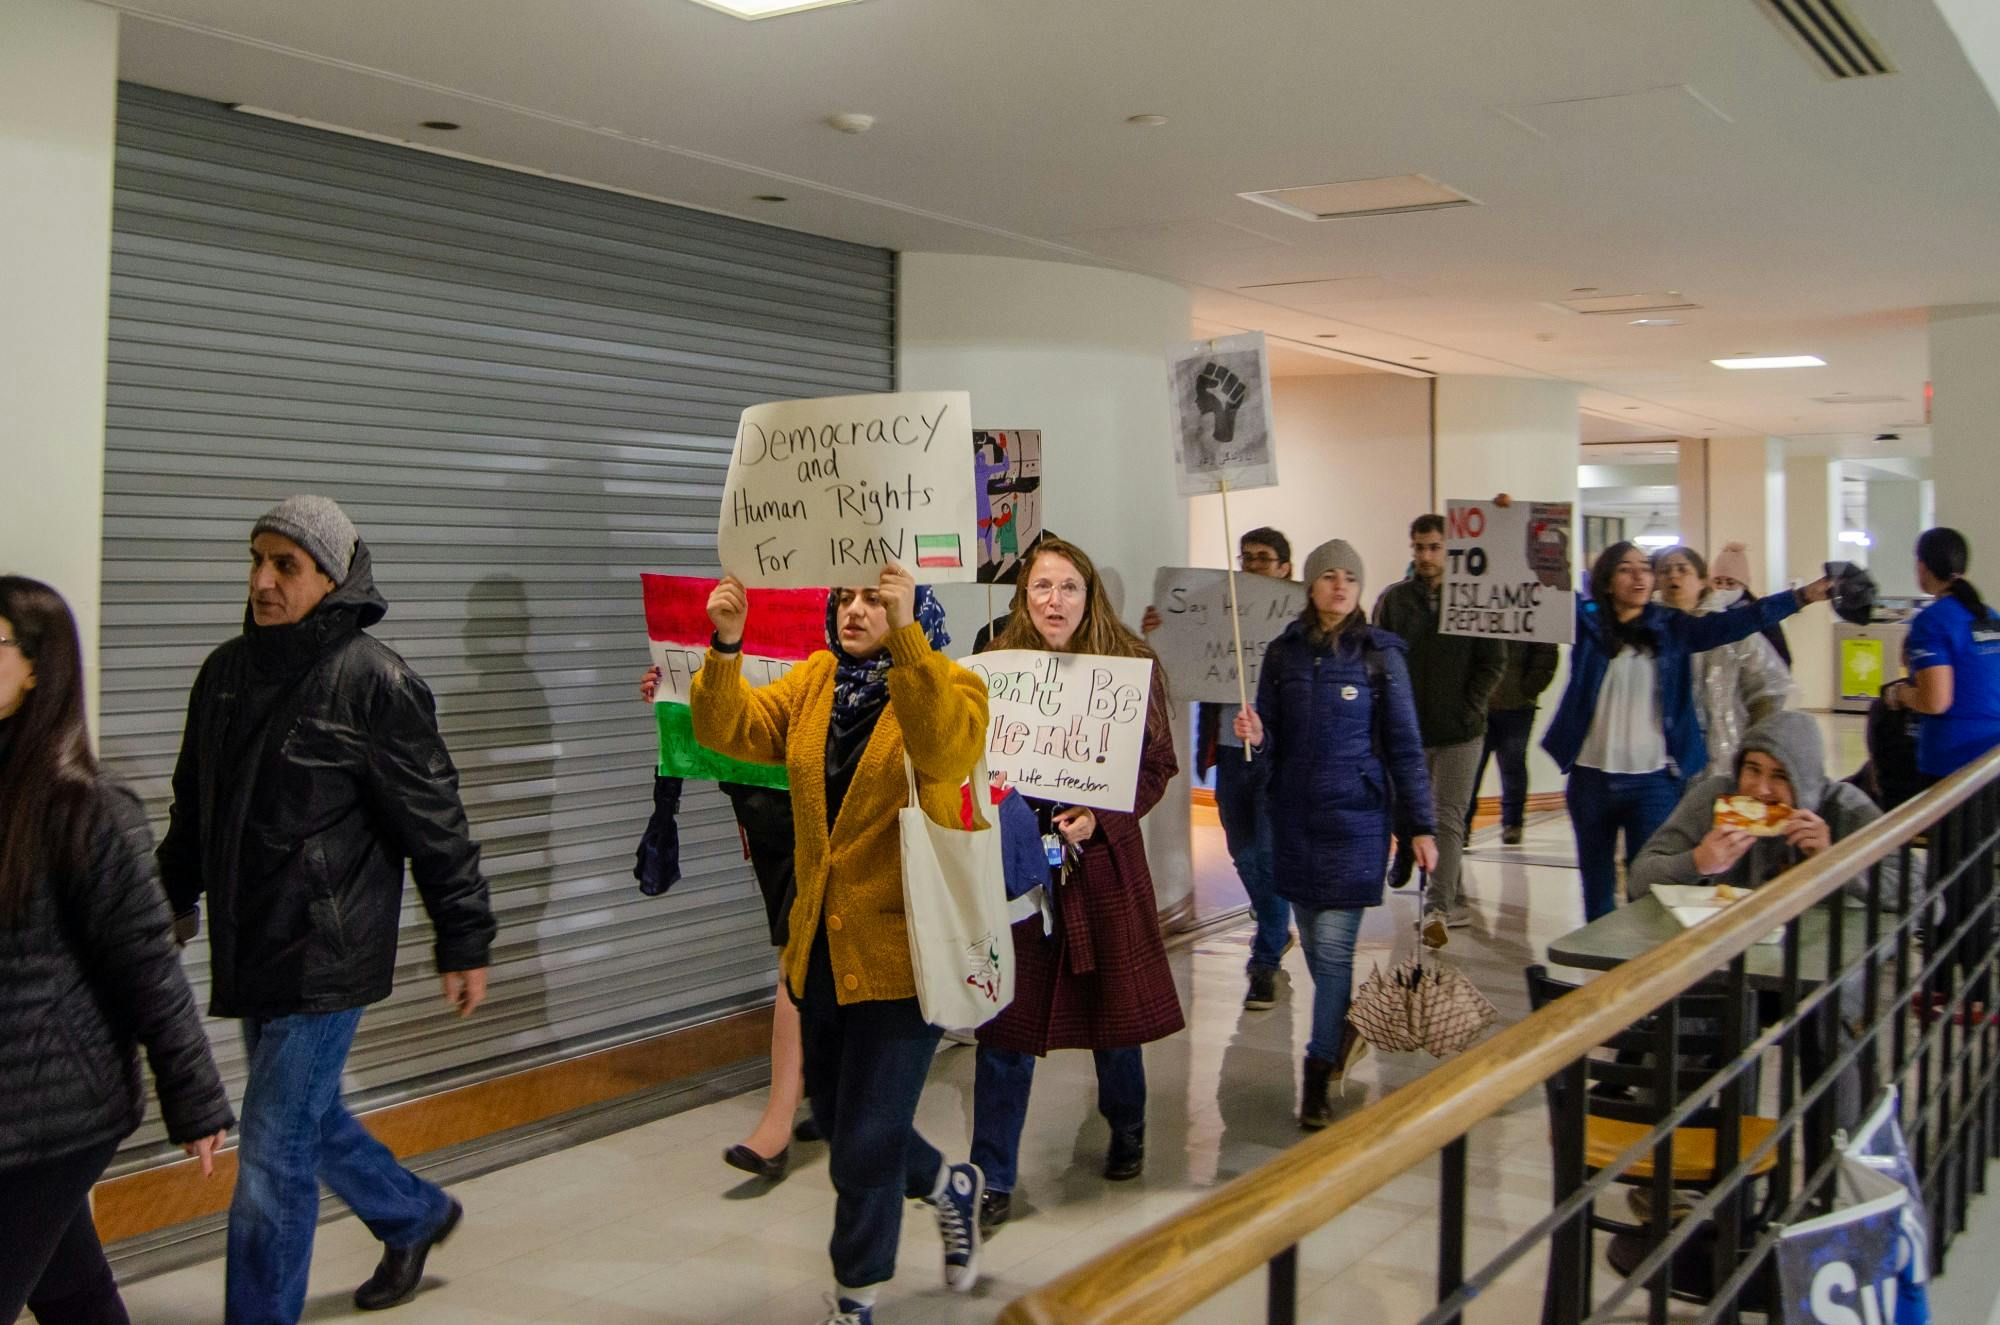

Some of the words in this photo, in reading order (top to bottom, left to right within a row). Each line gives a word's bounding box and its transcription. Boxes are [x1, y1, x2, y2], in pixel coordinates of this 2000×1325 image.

[797, 447, 840, 483] and
[734, 488, 807, 526] Human
[825, 473, 935, 525] Rights
[1447, 507, 1486, 539] NO
[755, 537, 798, 576] For
[830, 528, 904, 566] IRAN
[1448, 547, 1487, 577] TO
[1448, 582, 1541, 609] ISLAMIC
[1445, 609, 1535, 634] REPUBLIC
[1204, 641, 1267, 658] MAHS
[1087, 668, 1142, 724] Be
